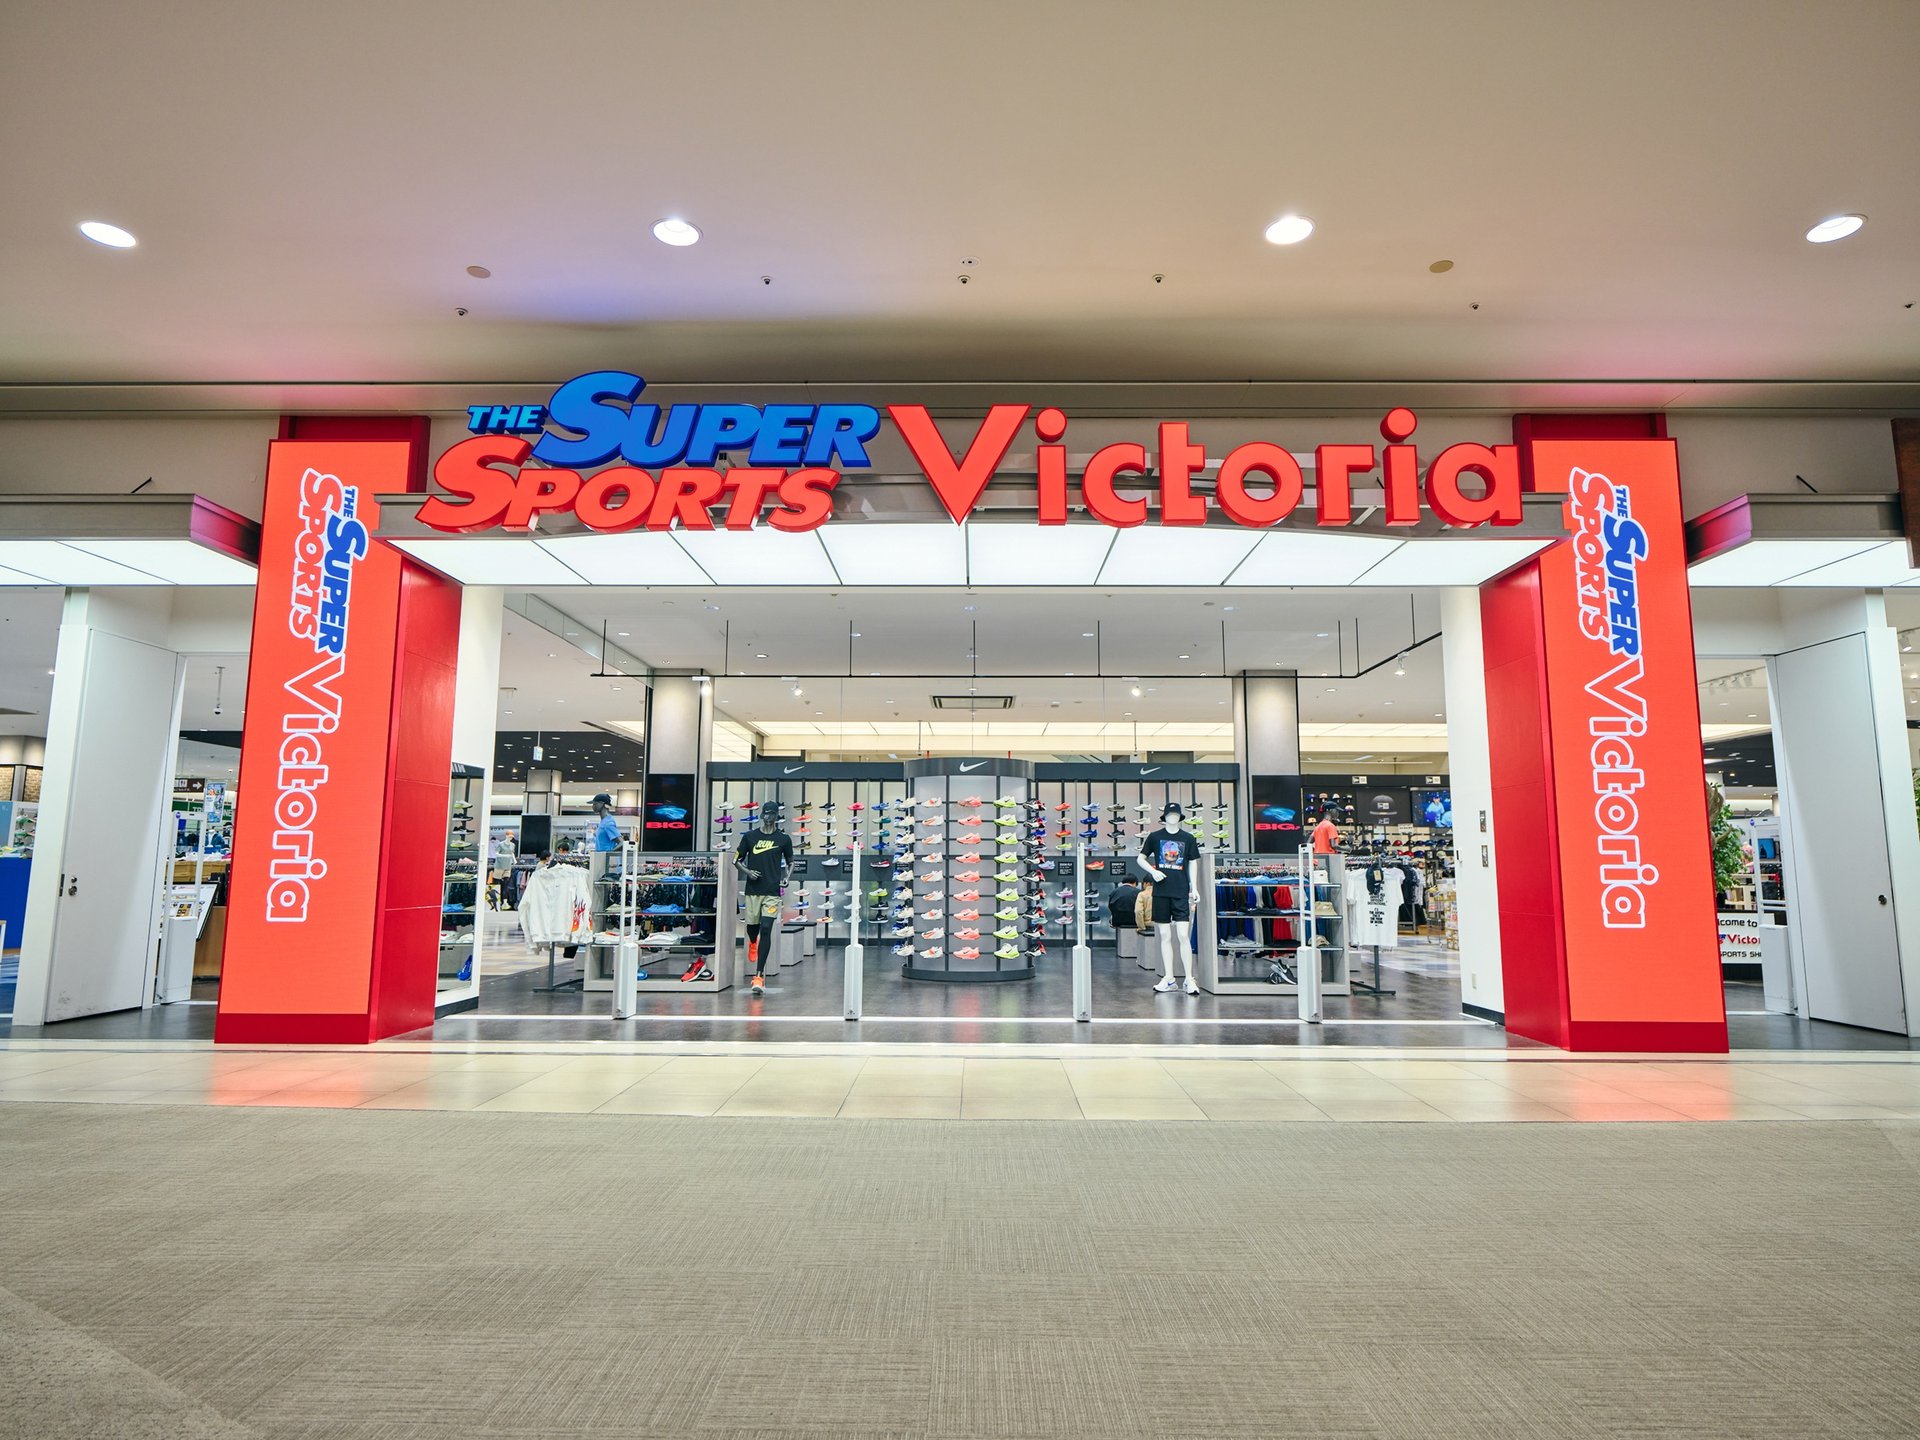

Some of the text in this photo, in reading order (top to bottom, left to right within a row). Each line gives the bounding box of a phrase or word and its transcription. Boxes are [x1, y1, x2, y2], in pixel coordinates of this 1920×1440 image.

[414, 434, 841, 533] SPORTS
[467, 370, 880, 469] THE SUPER
[887, 404, 1524, 528] Victoria
[288, 467, 346, 640] SPORTS
[317, 486, 368, 654] THE SUPER
[1568, 466, 1617, 642] SPORTS
[1606, 487, 1649, 656] THE SUPER
[266, 652, 345, 923] Victoria
[1584, 656, 1660, 929] Victoria
[1747, 919, 1758, 928] to
